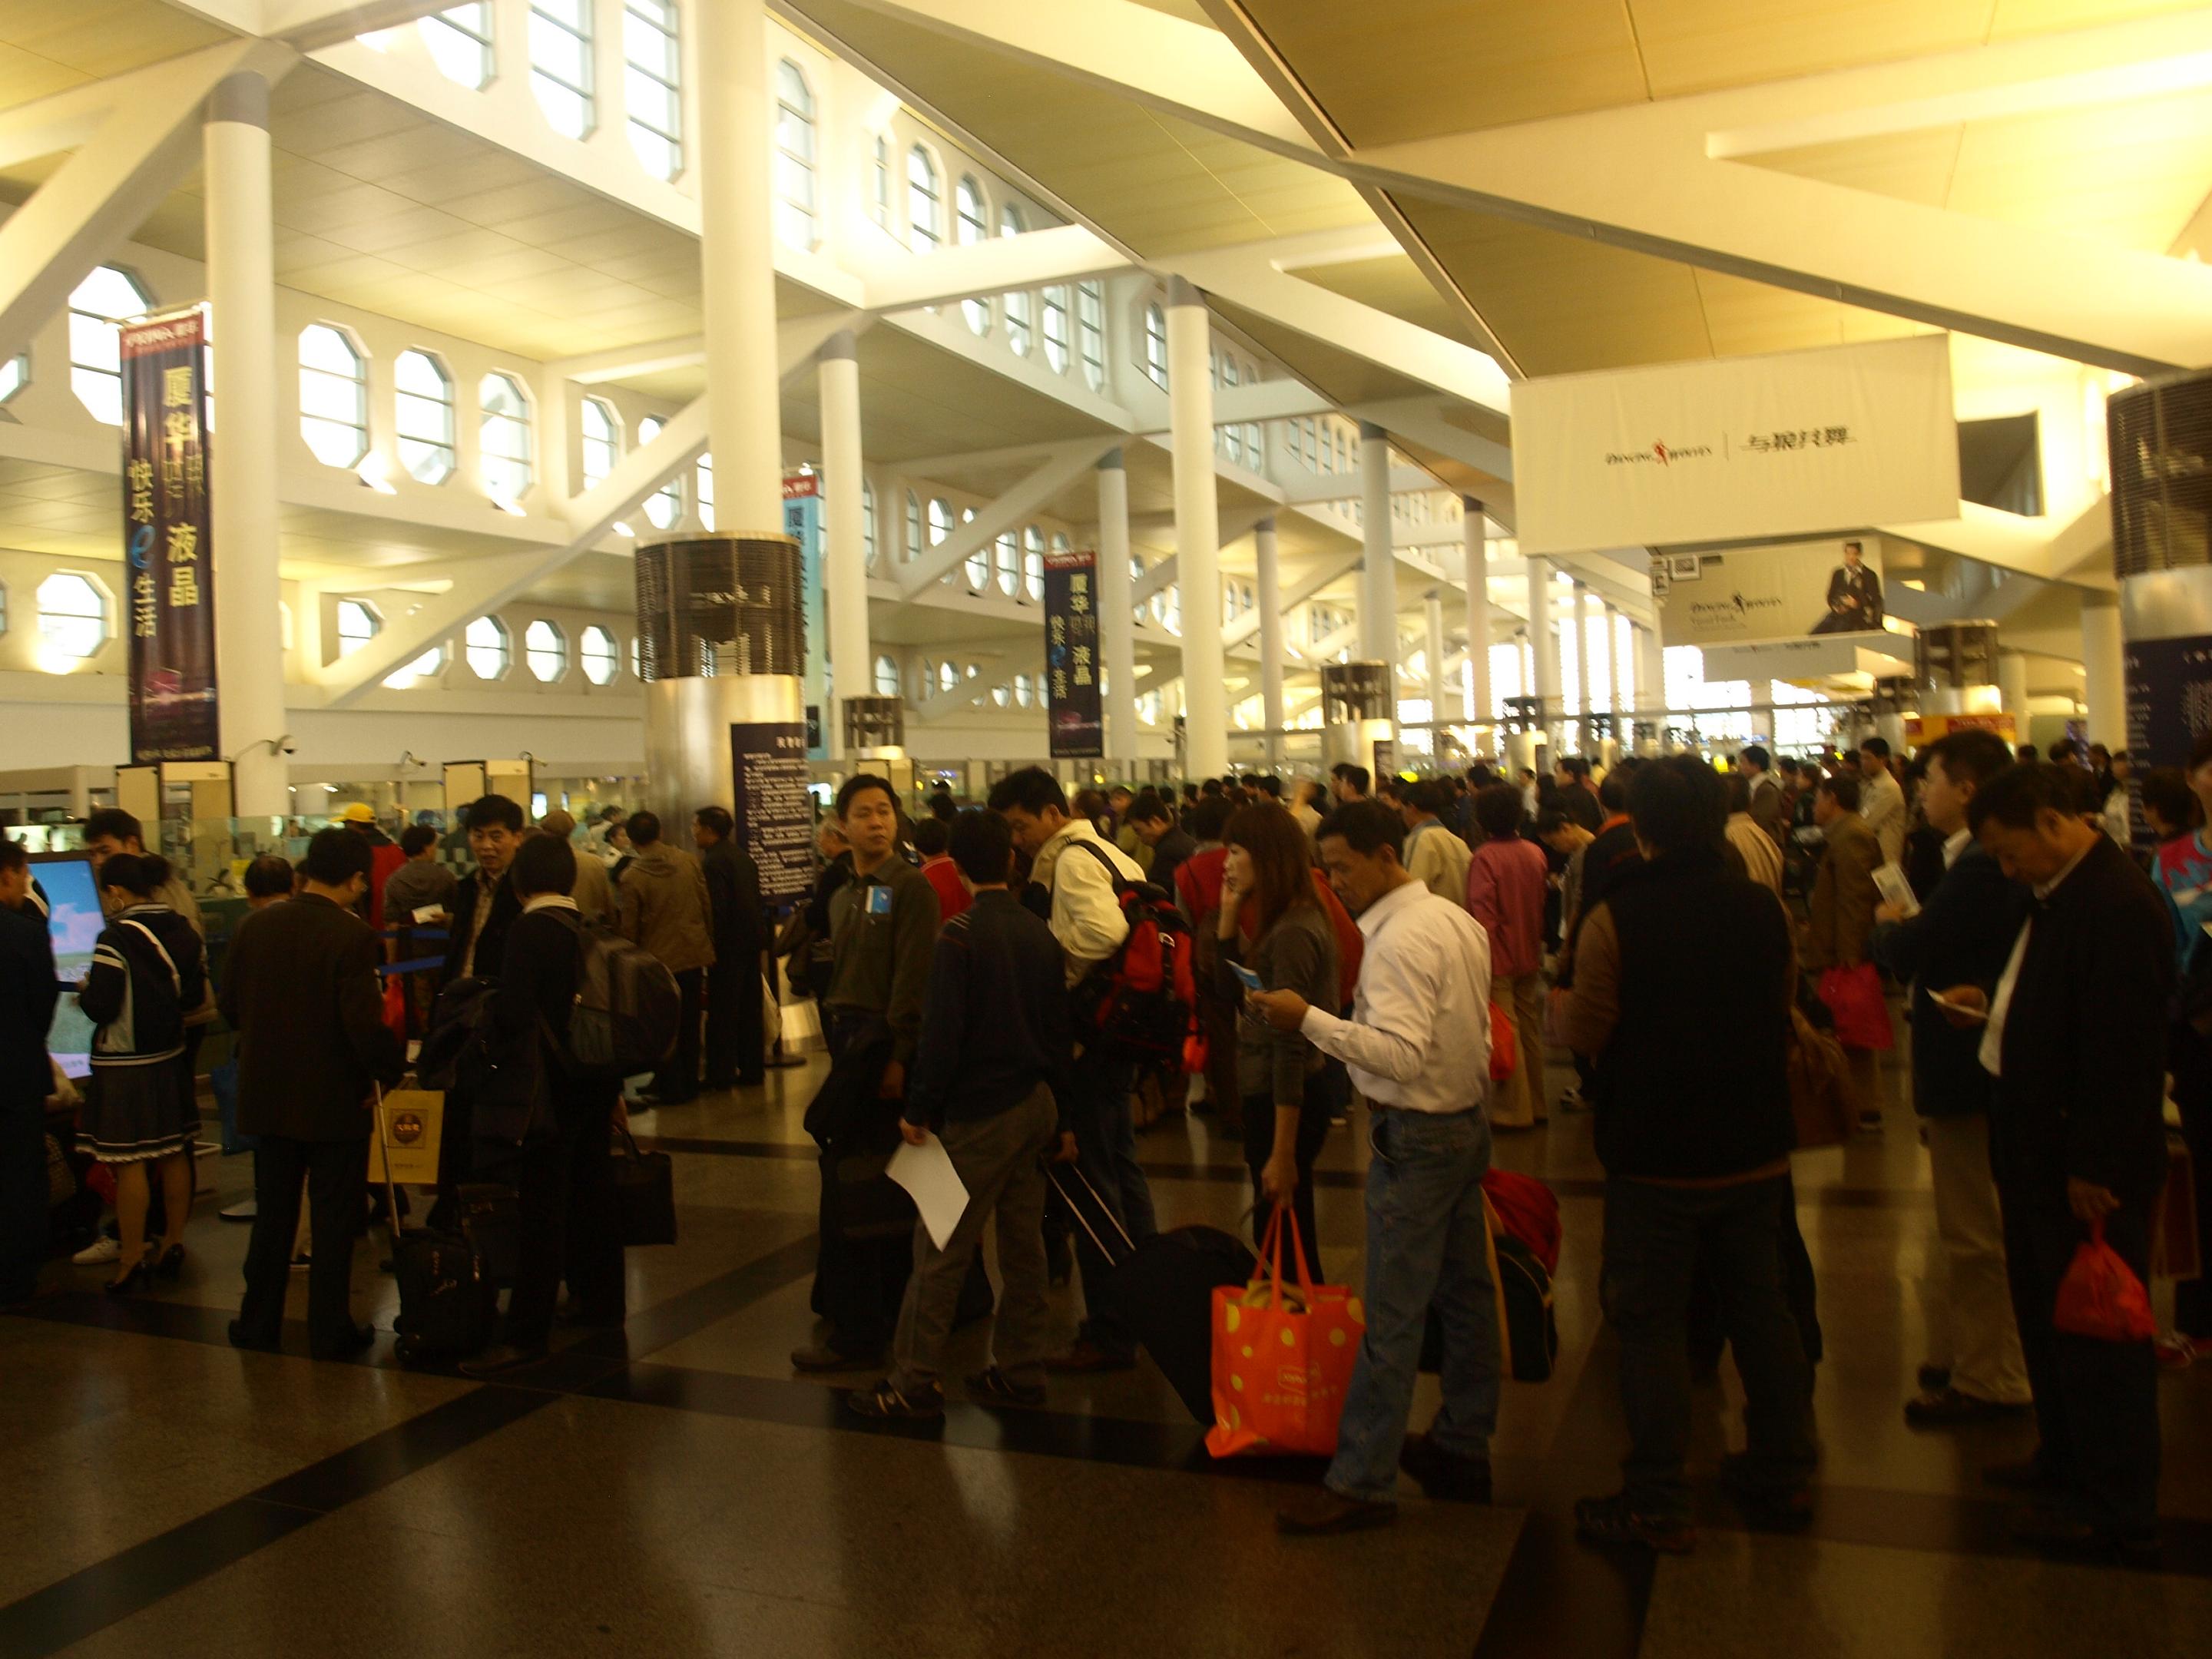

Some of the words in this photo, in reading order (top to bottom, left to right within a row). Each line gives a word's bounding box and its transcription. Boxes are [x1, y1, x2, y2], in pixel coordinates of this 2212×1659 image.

[1743, 424, 1855, 452] 与狼共舞
[167, 522, 199, 608] 液晶
